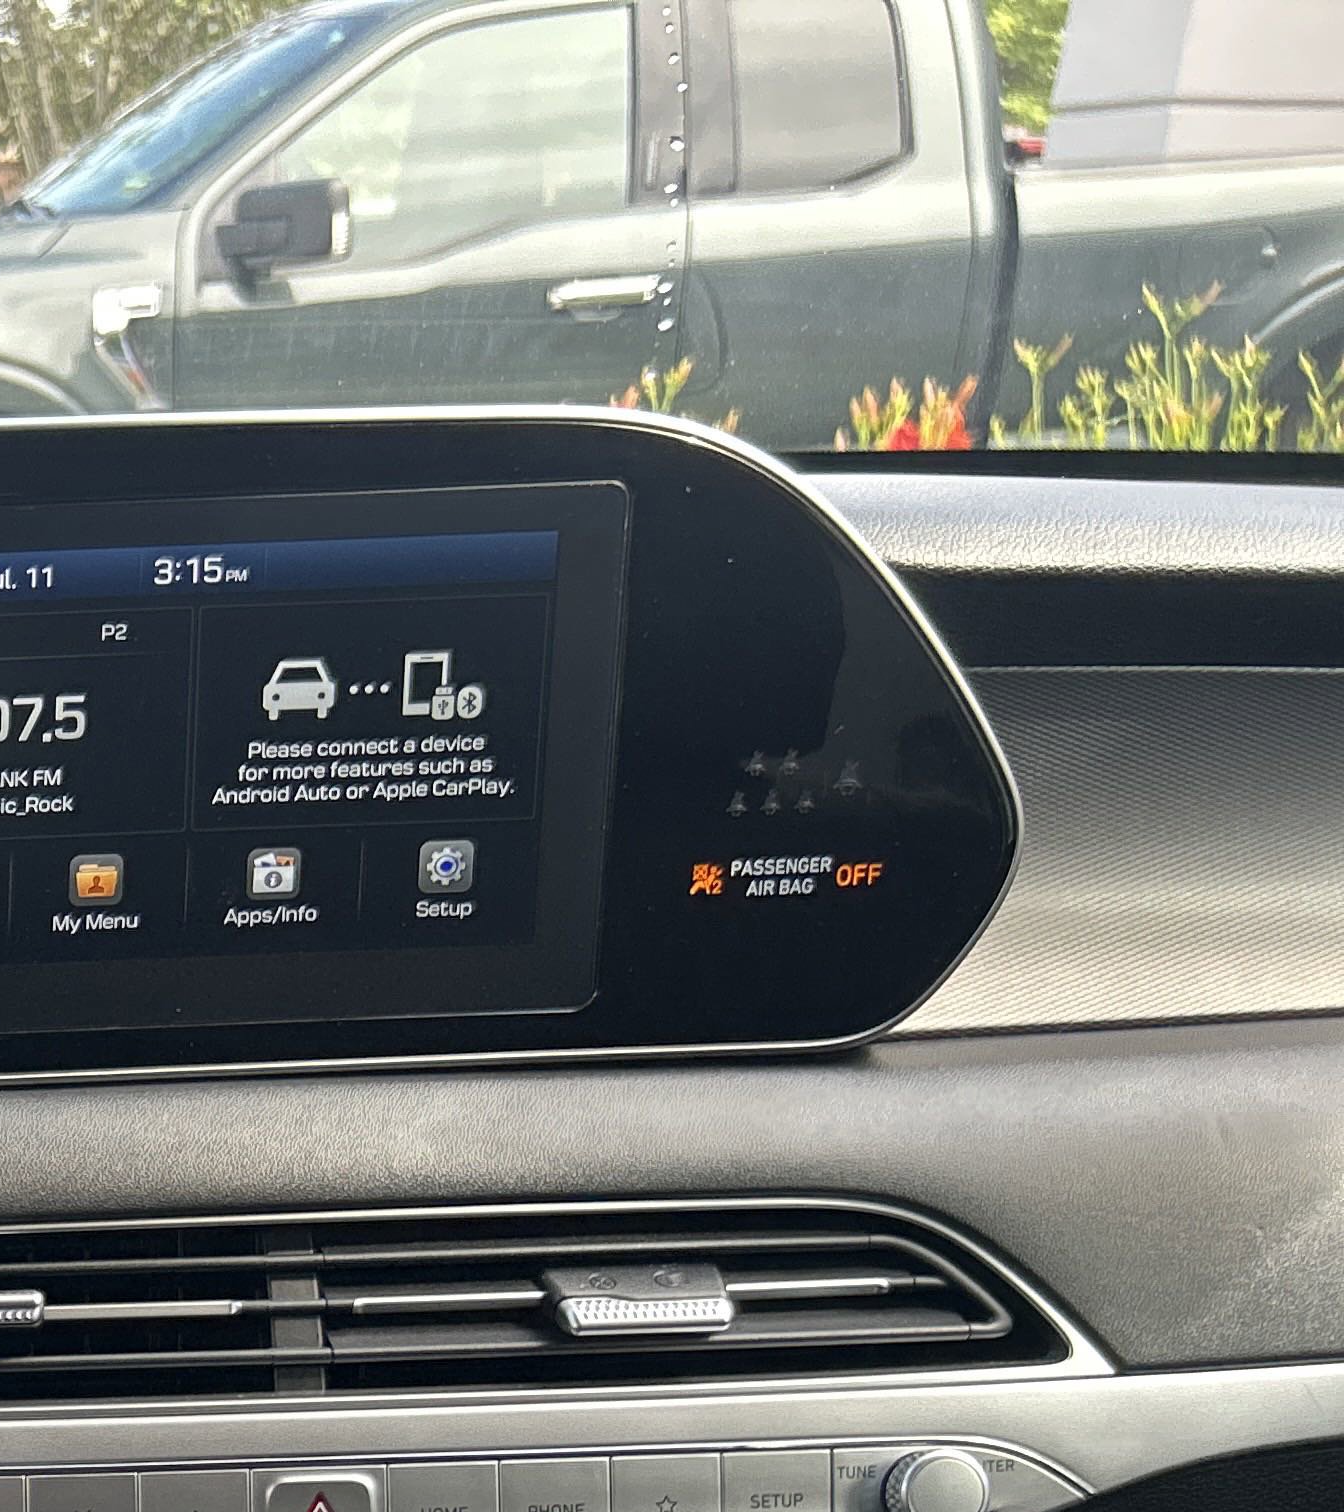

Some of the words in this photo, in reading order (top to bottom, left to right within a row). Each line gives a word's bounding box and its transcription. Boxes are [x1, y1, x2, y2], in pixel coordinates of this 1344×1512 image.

[26, 566, 55, 589] 11
[101, 623, 129, 642] P2
[248, 740, 313, 760] Please
[317, 737, 399, 758] connect
[403, 740, 416, 755] a
[421, 734, 486, 754] device
[33, 767, 64, 788] FM
[238, 762, 269, 782] for
[273, 764, 325, 781] more
[331, 759, 414, 779] features
[419, 757, 466, 776] such
[469, 759, 494, 774] as
[212, 785, 290, 805] Android
[294, 784, 342, 802] Auto
[346, 786, 369, 801] or
[372, 780, 429, 803] Apple
[432, 777, 516, 801] CarPlay.
[730, 856, 833, 877] PASSENGER
[835, 862, 884, 888] OFF
[746, 879, 775, 897] AIR
[778, 877, 815, 896] BAG
[223, 904, 318, 927] Apps/Info
[415, 900, 473, 922] Setup
[52, 914, 81, 934] My
[84, 911, 139, 931] Menu
[837, 1464, 877, 1480] TUNE
[750, 1493, 804, 1510] SETUP
